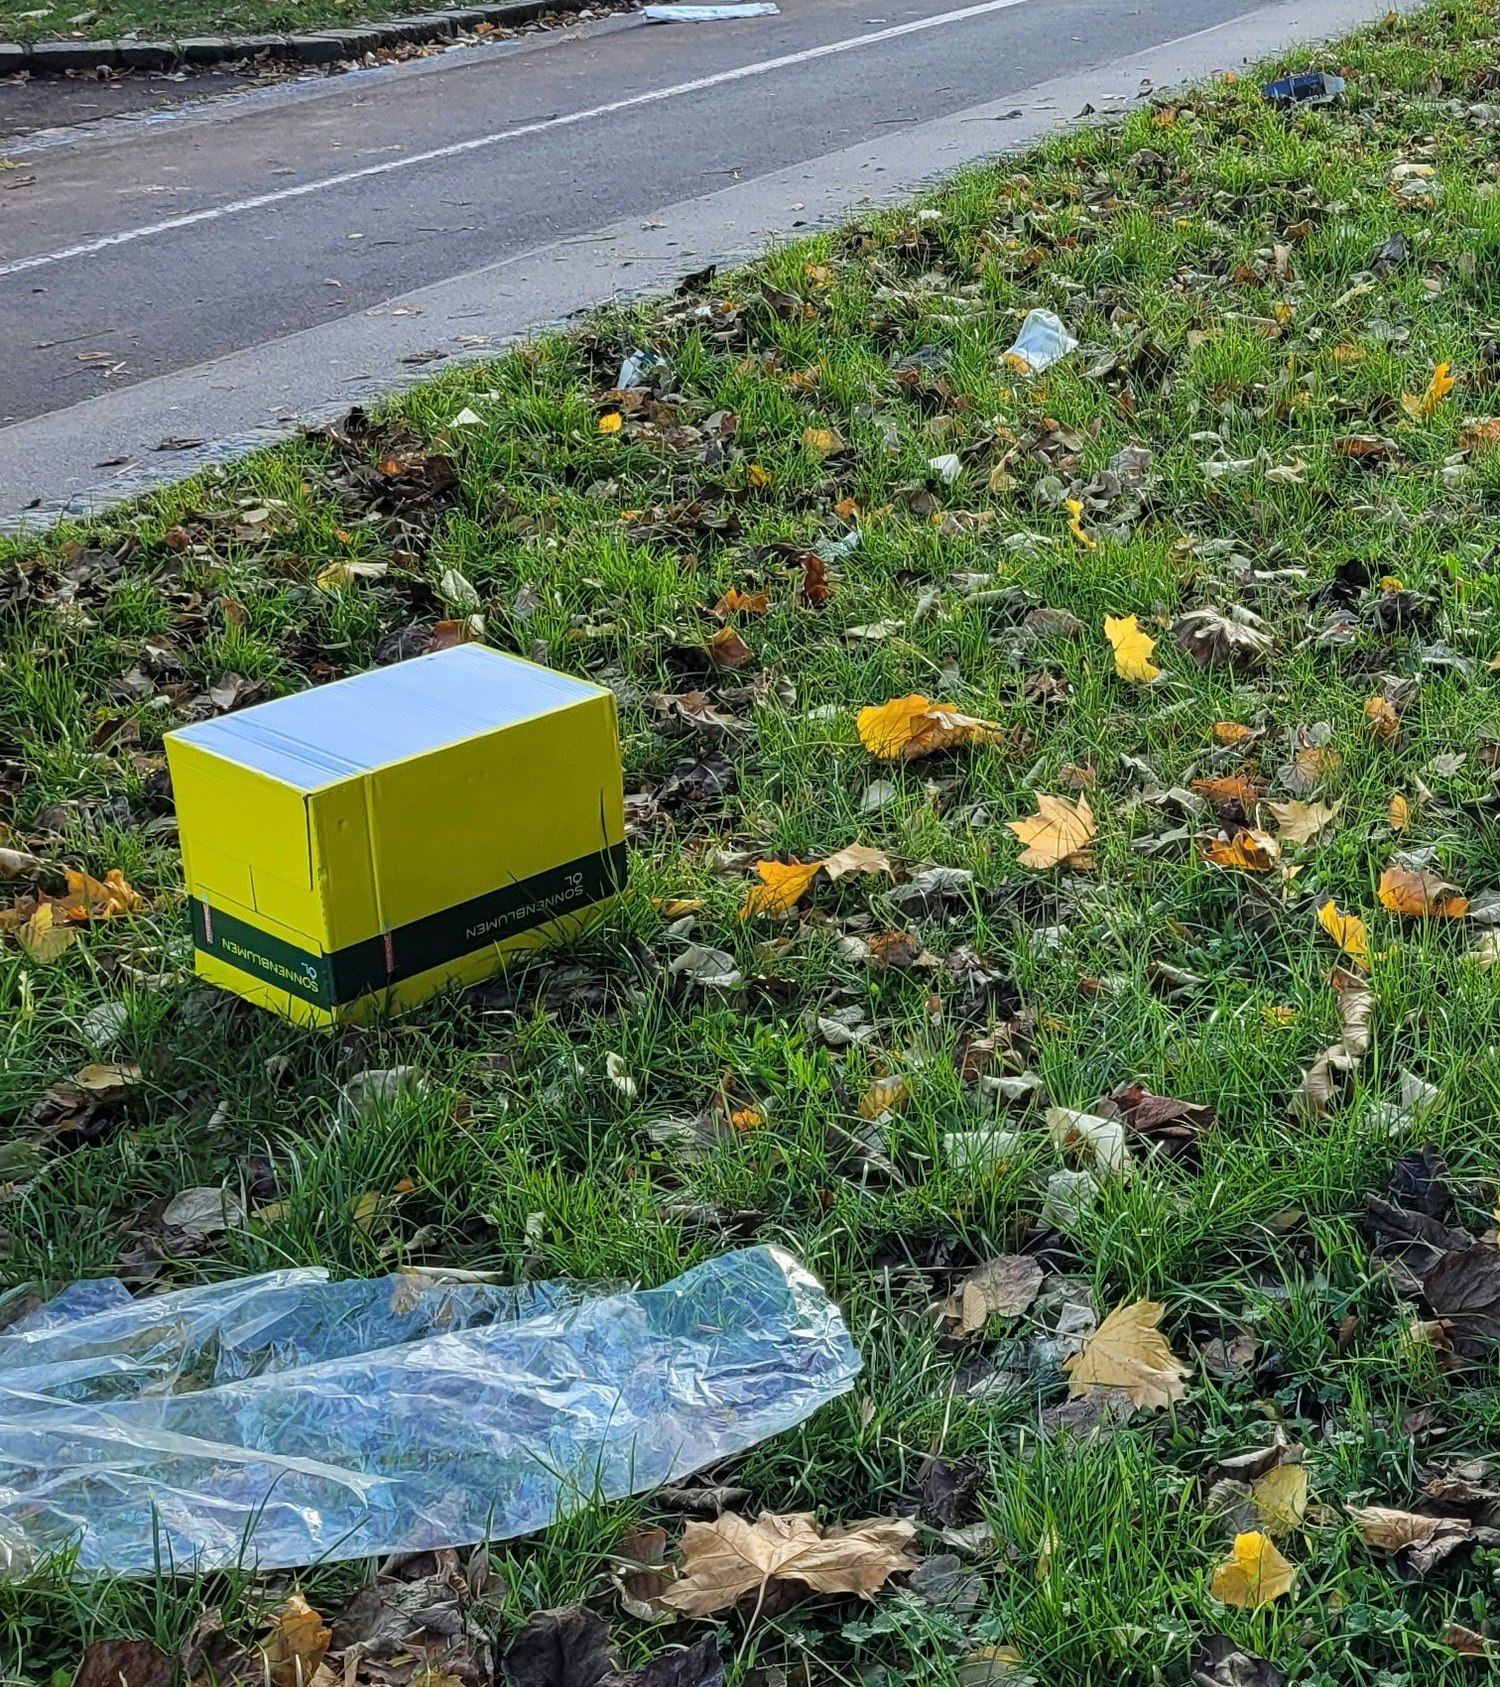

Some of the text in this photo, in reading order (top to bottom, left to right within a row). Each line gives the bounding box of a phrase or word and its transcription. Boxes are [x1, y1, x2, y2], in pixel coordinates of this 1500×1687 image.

[564, 872, 583, 886] ÖL
[465, 884, 584, 940] SONNENBLUMEN
[221, 938, 319, 993] SONNENBLUMEN
[301, 962, 317, 979] ÖL
